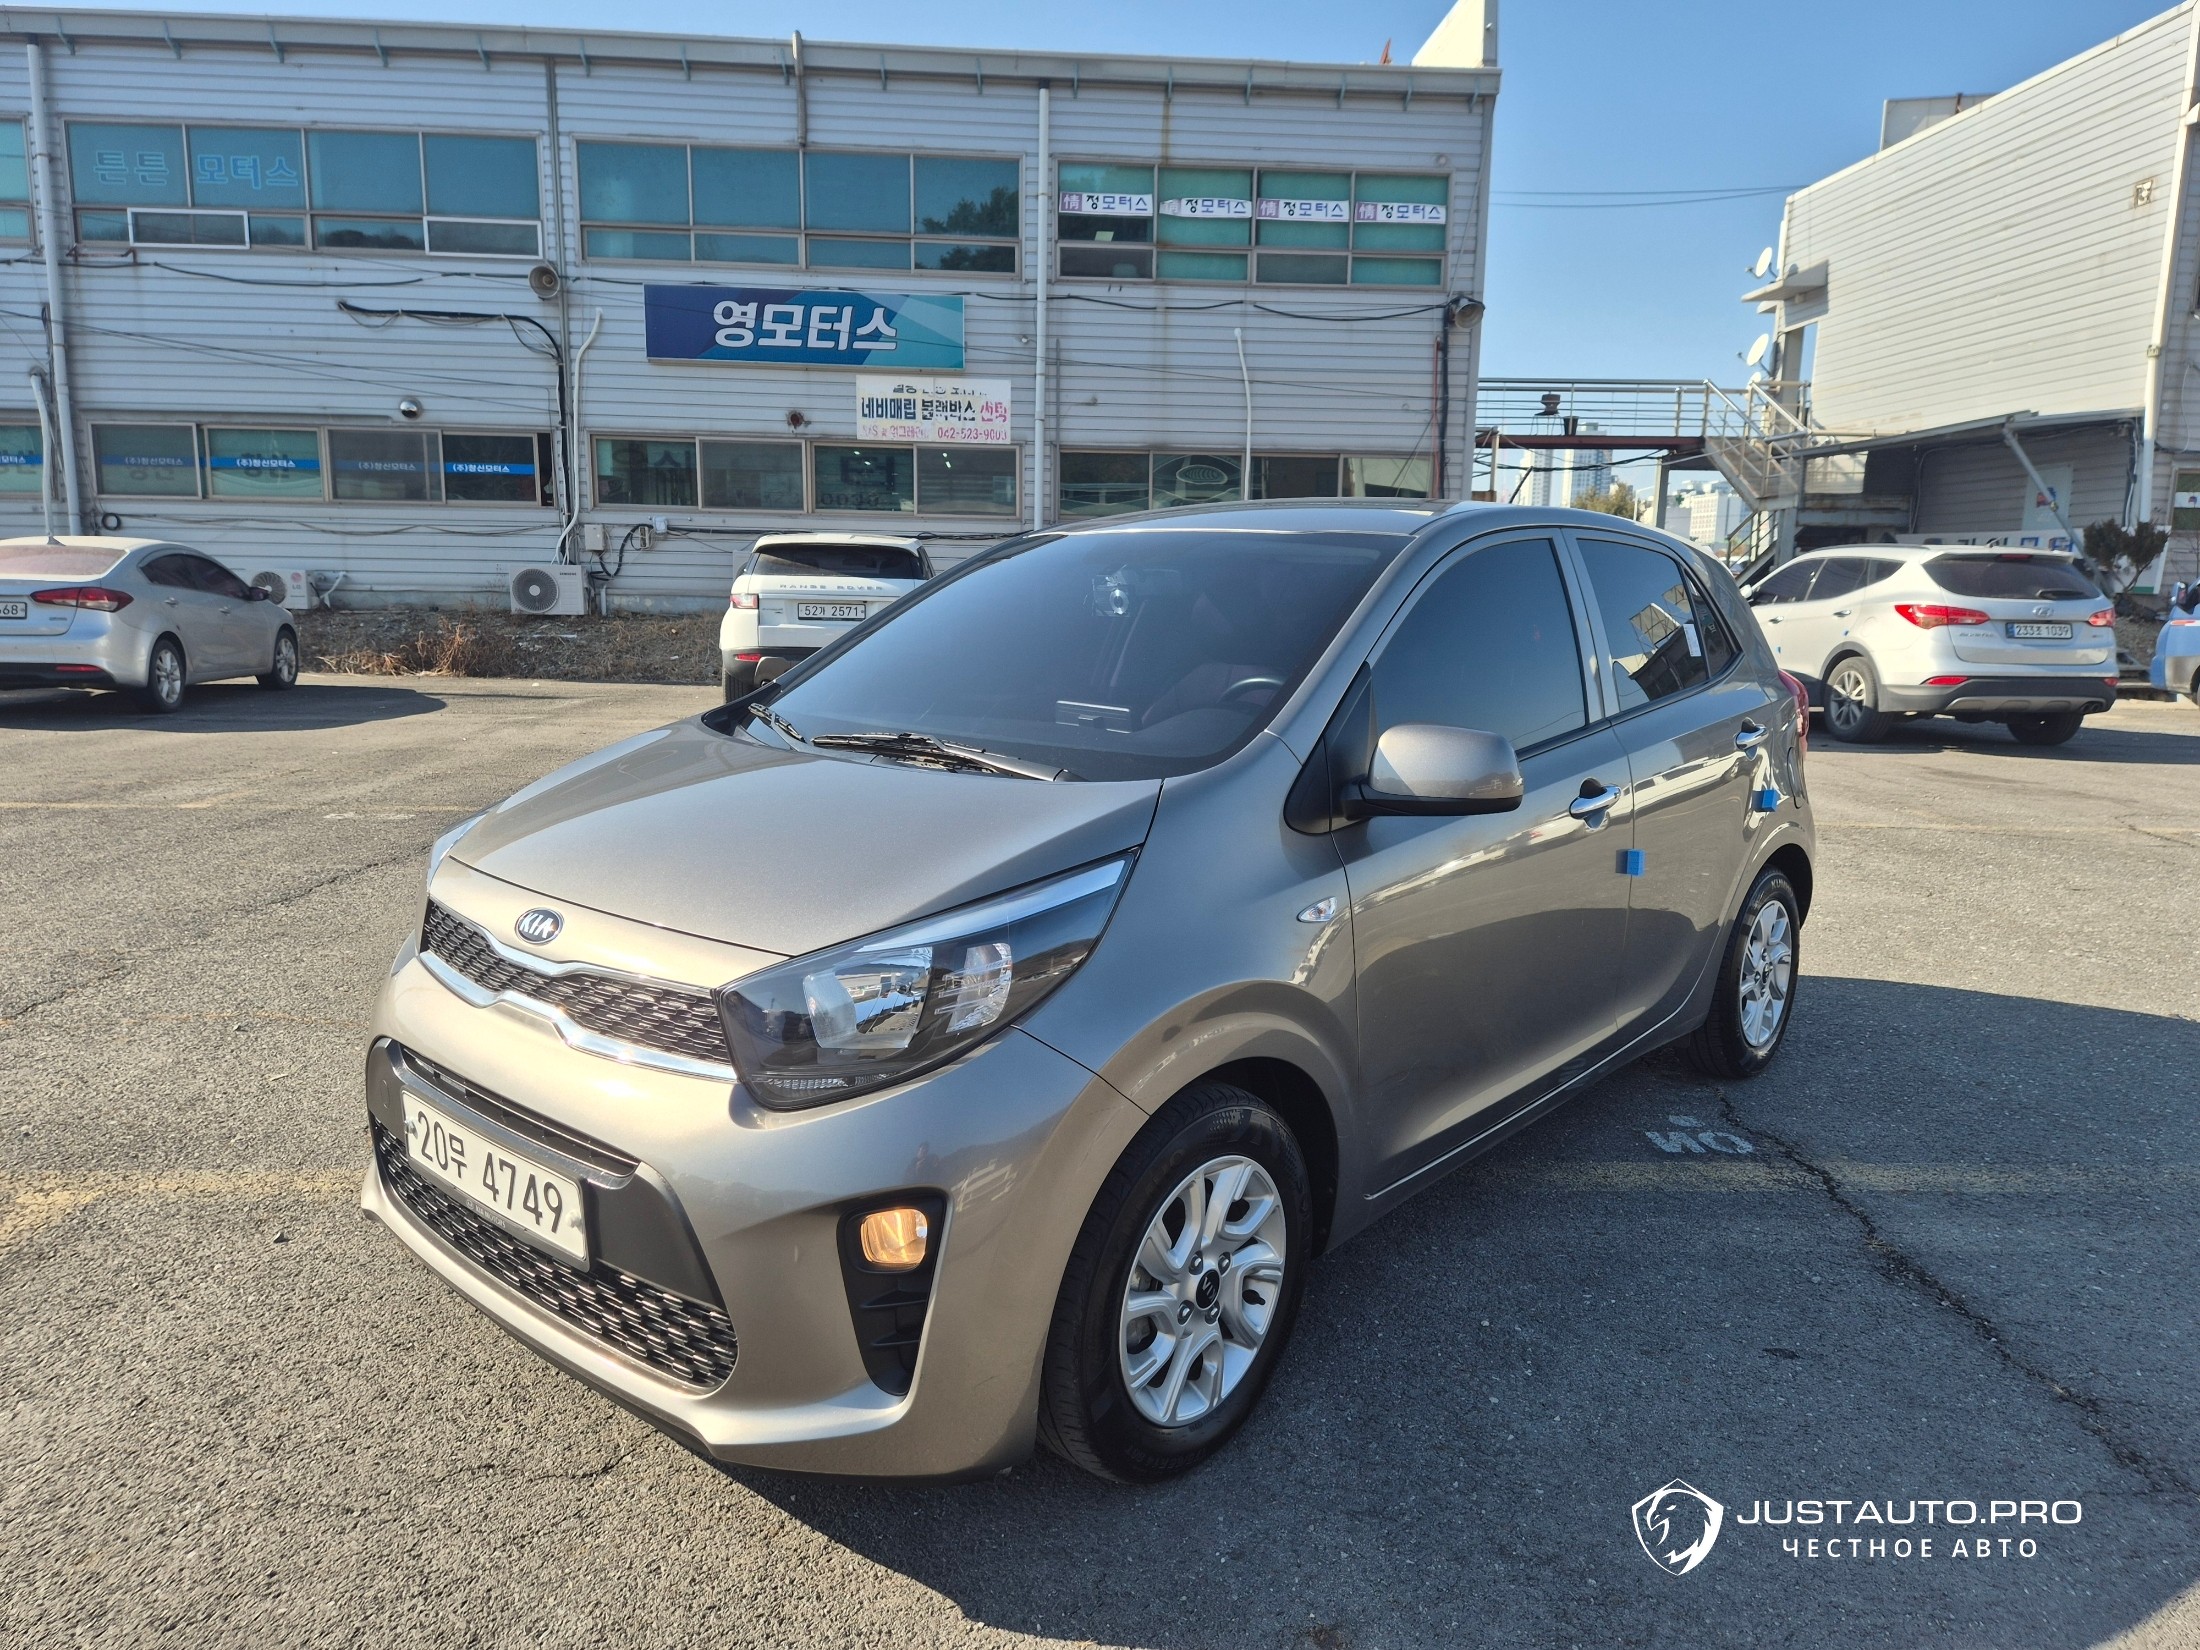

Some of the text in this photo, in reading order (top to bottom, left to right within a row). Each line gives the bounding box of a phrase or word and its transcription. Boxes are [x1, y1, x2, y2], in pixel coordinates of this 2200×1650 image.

[93, 151, 299, 190] 튼튼 모터스
[713, 300, 898, 351] 영모터스
[861, 397, 917, 420] 네비매립
[0, 455, 26, 464] 모터스
[0, 604, 18, 615] 68
[804, 605, 859, 617] 52가 2571
[2045, 626, 2069, 637] 1039
[417, 1110, 563, 1233] 20무 4749
